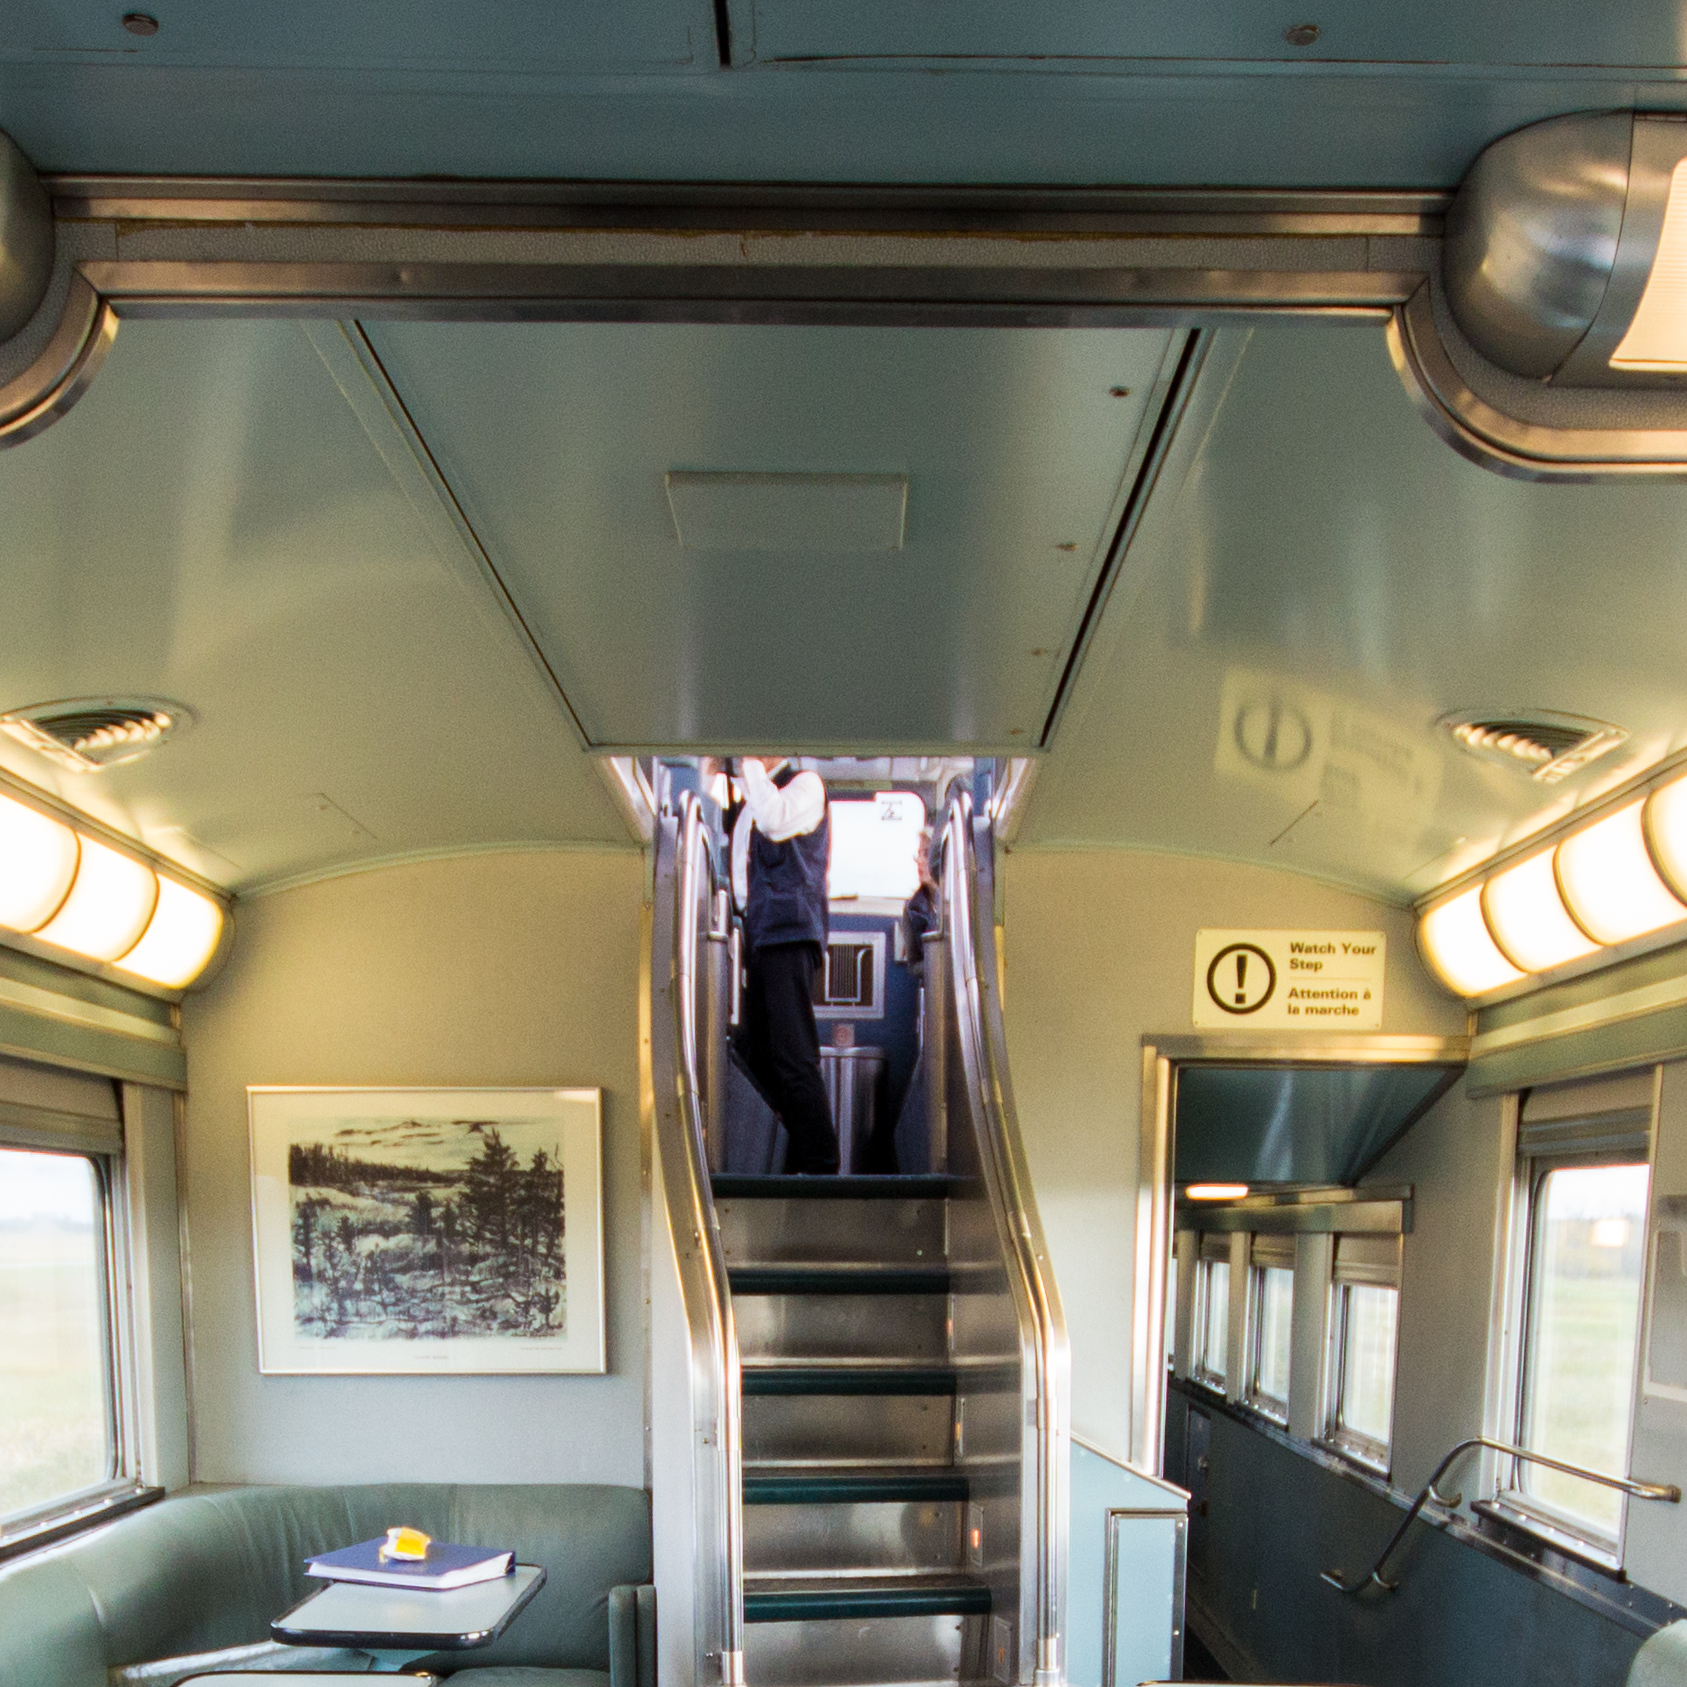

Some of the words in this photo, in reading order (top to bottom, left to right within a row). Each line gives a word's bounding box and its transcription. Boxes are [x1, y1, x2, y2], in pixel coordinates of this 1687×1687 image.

[1290, 942, 1336, 954] Watch
[1341, 942, 1377, 954] Your
[1289, 958, 1323, 973] Step
[1288, 987, 1358, 1000] Attention
[1363, 987, 1372, 1000] à
[1287, 1003, 1300, 1015] la
[1305, 1004, 1360, 1016] marche
